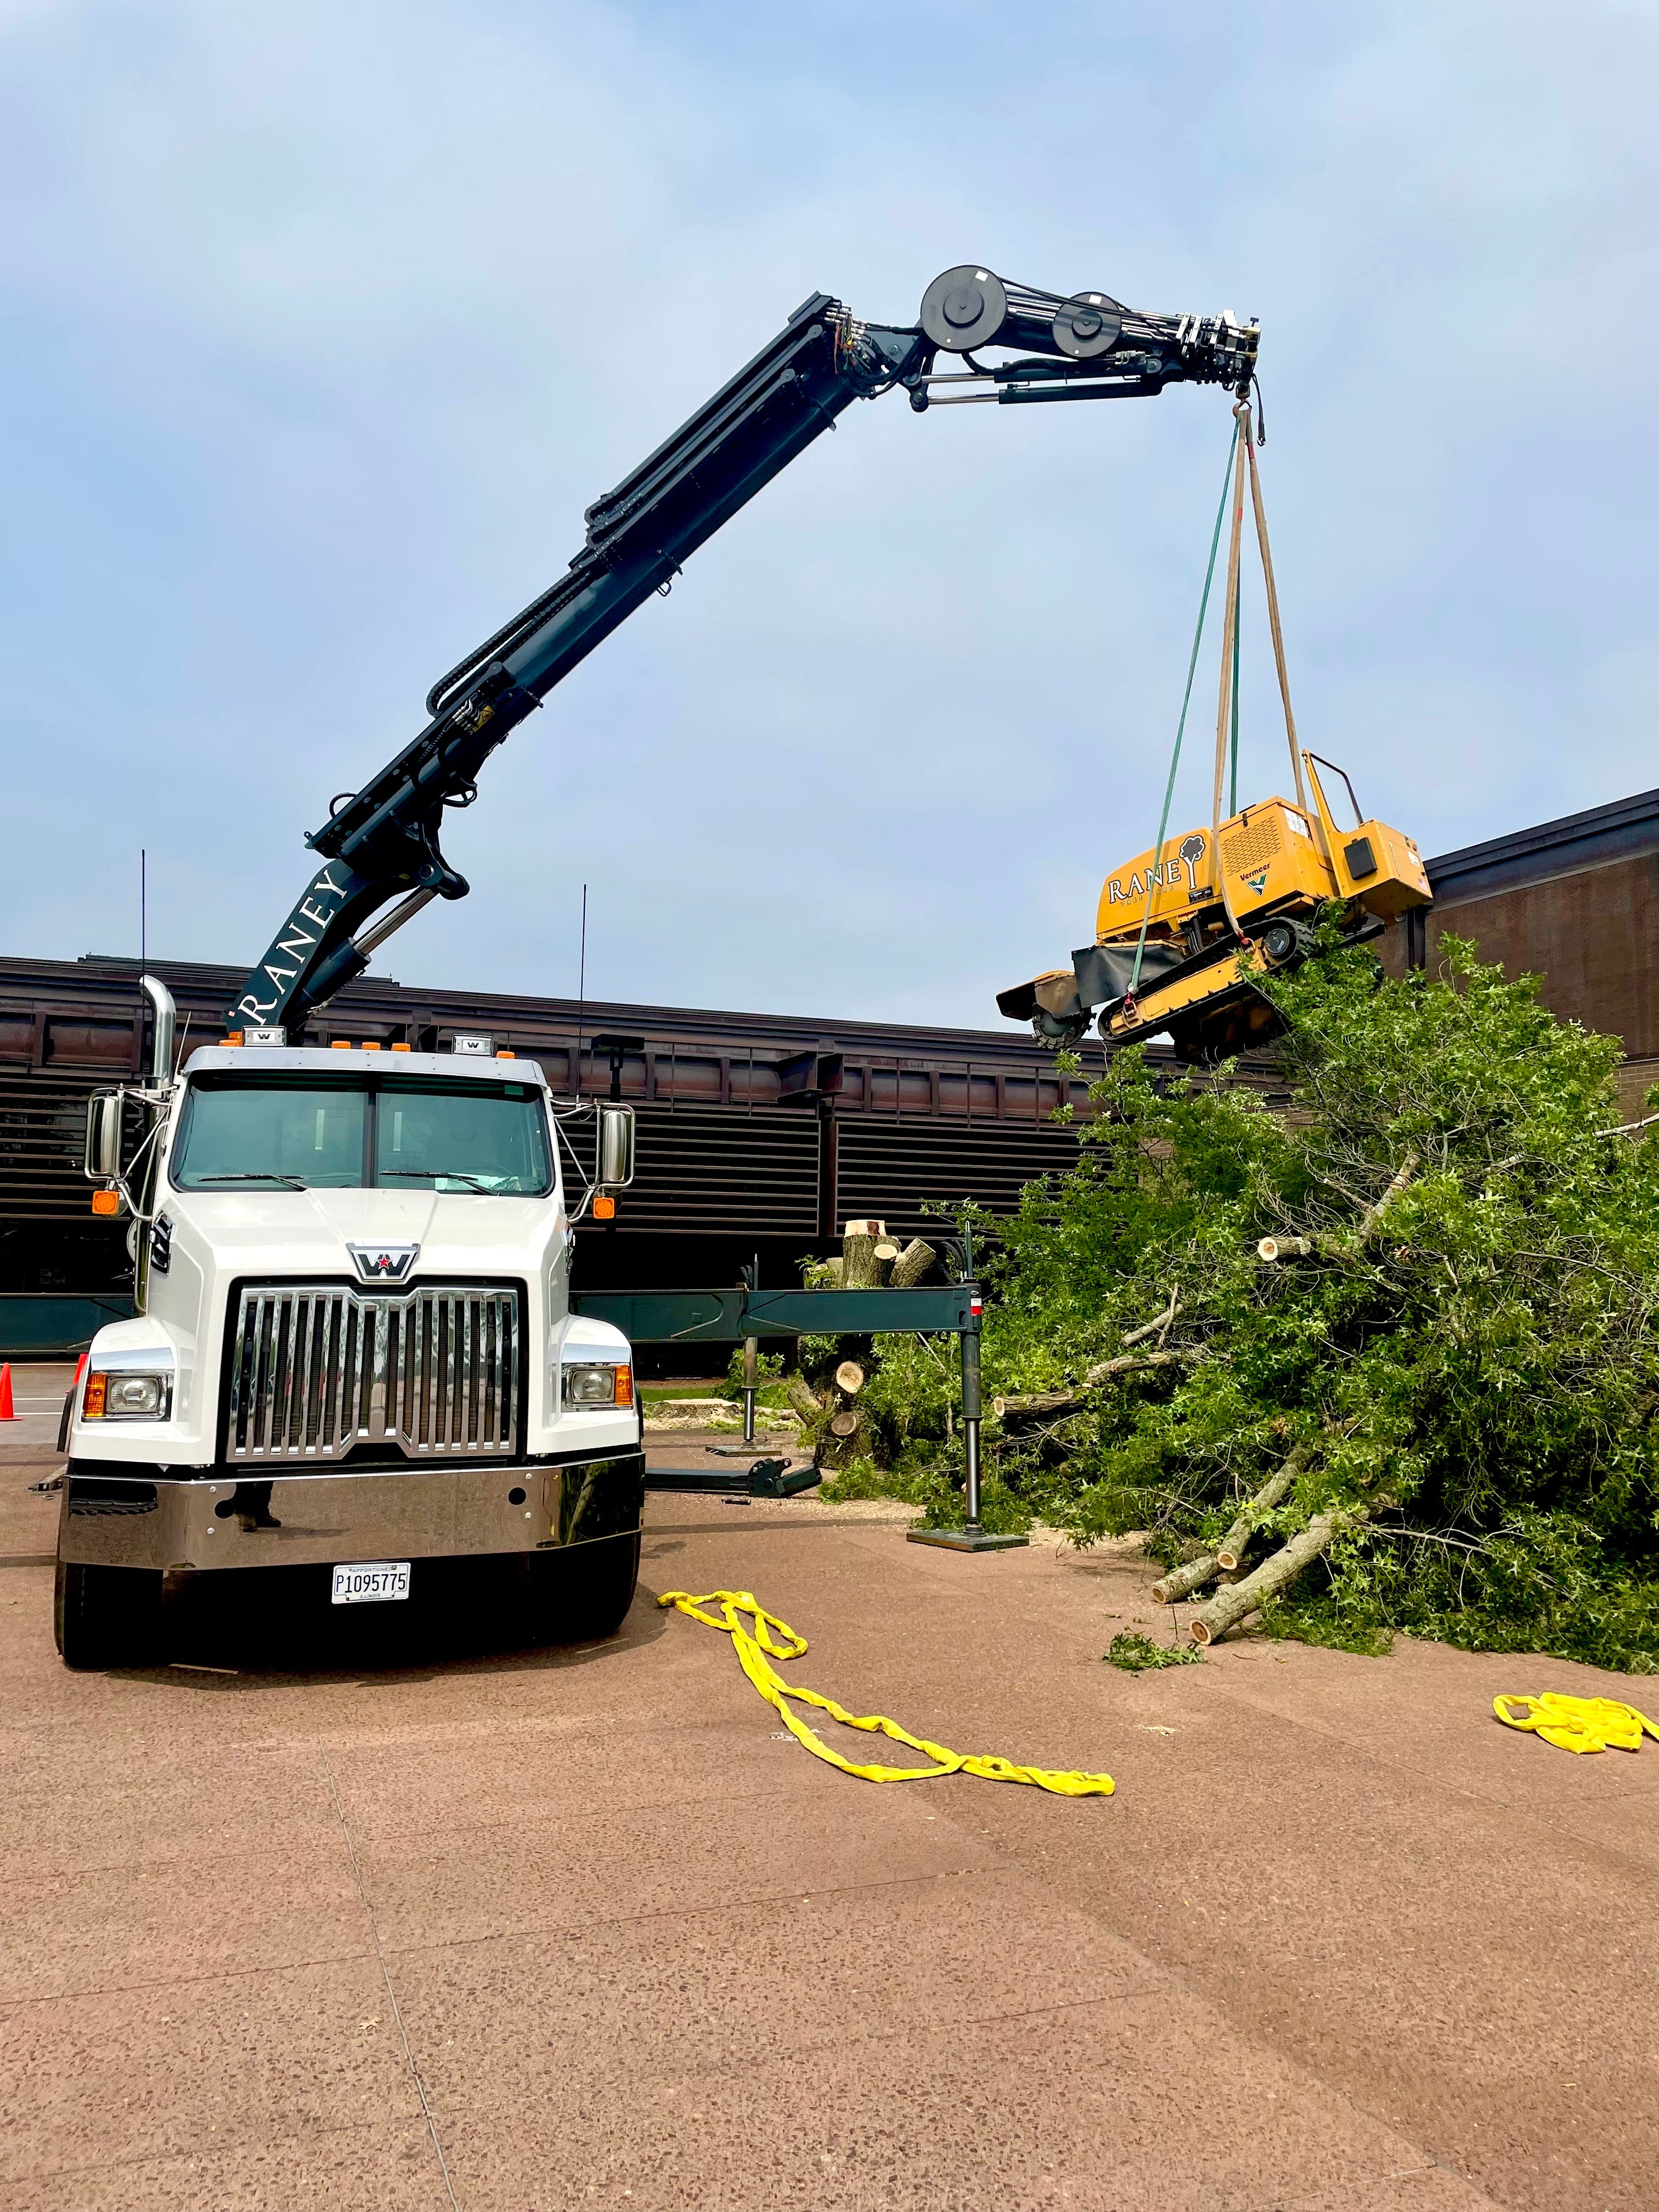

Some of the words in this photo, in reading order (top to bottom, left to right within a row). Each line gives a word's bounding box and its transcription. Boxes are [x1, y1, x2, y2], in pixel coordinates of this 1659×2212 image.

[1108, 853, 1197, 903] RANEY
[1240, 863, 1270, 881] Vermeer
[1121, 895, 1143, 906] TREE
[1151, 885, 1173, 898] ARE
[238, 869, 347, 1026] RANEY
[336, 1573, 407, 1593] P1095775
